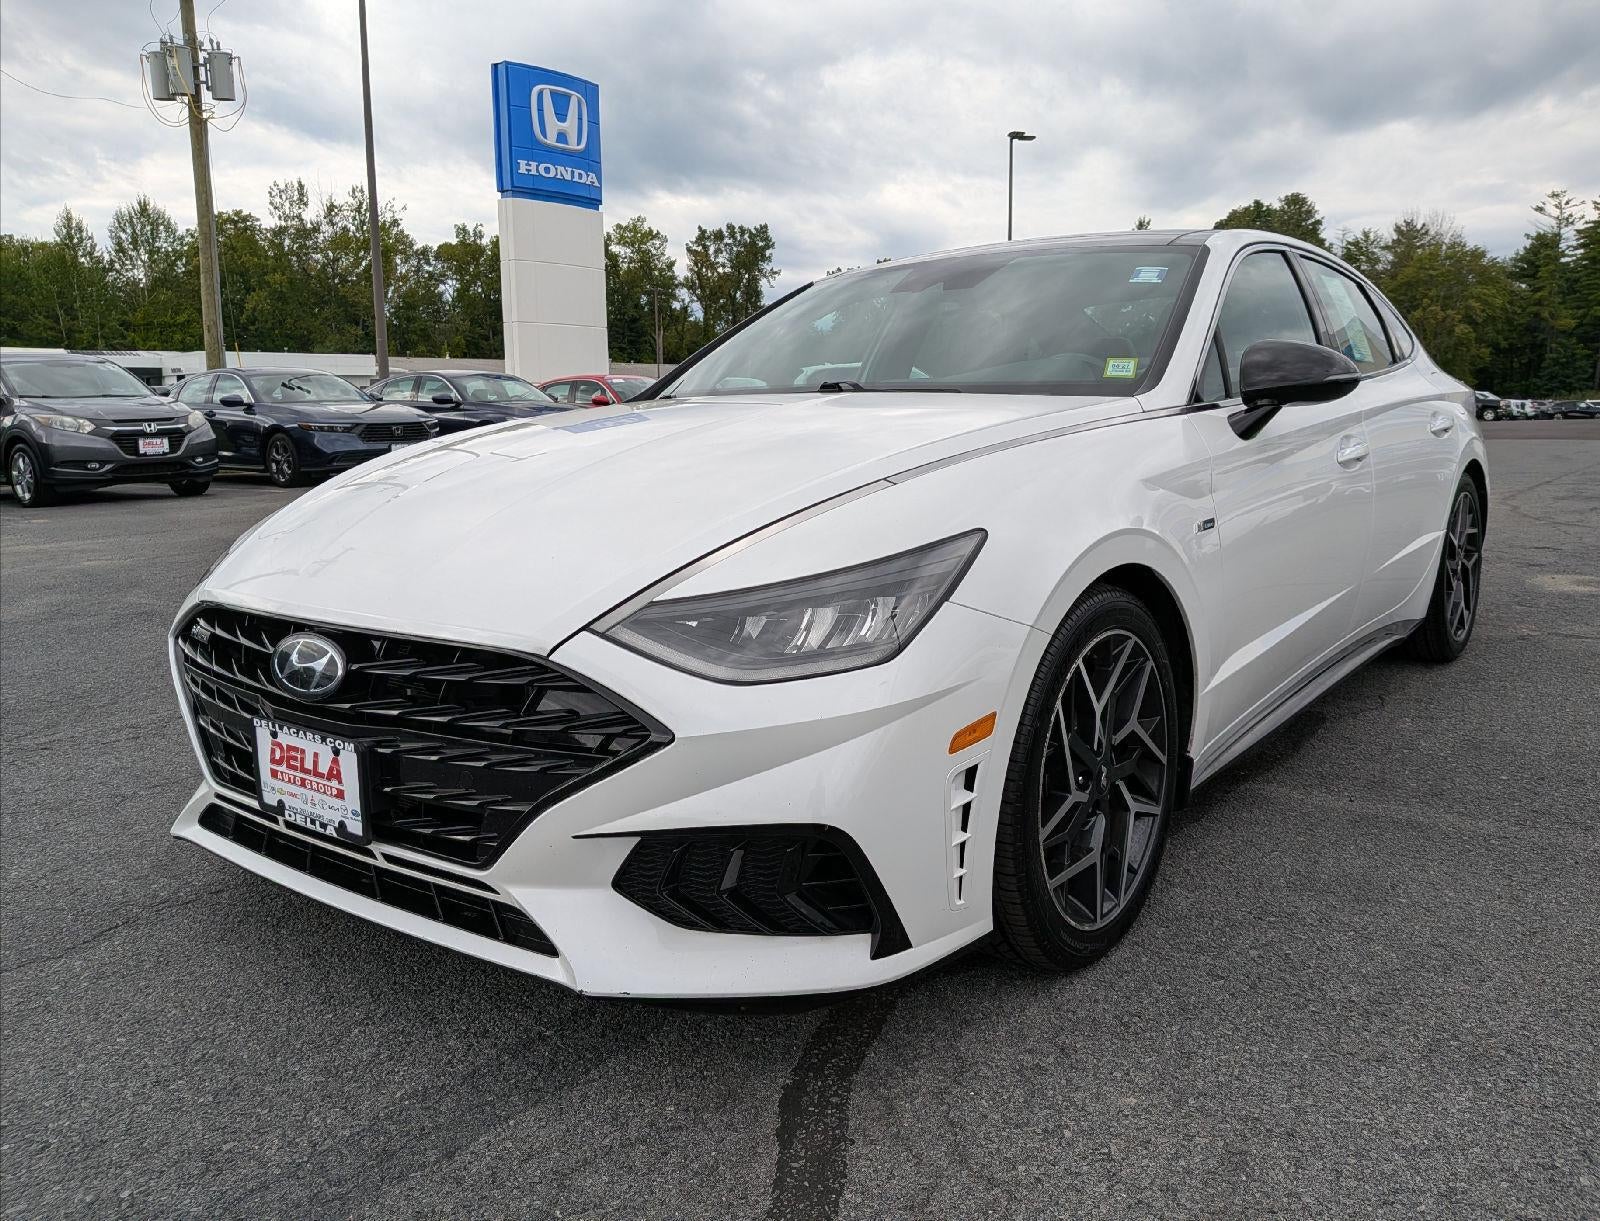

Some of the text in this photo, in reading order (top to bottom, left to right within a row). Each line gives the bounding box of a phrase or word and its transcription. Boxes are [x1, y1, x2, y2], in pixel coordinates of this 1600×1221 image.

[517, 160, 600, 187] HONDA
[253, 718, 355, 753] DELLACARS.COM
[270, 739, 344, 785] DELLA
[277, 771, 338, 796] AUTO GROUP
[284, 811, 338, 837] DELLA
